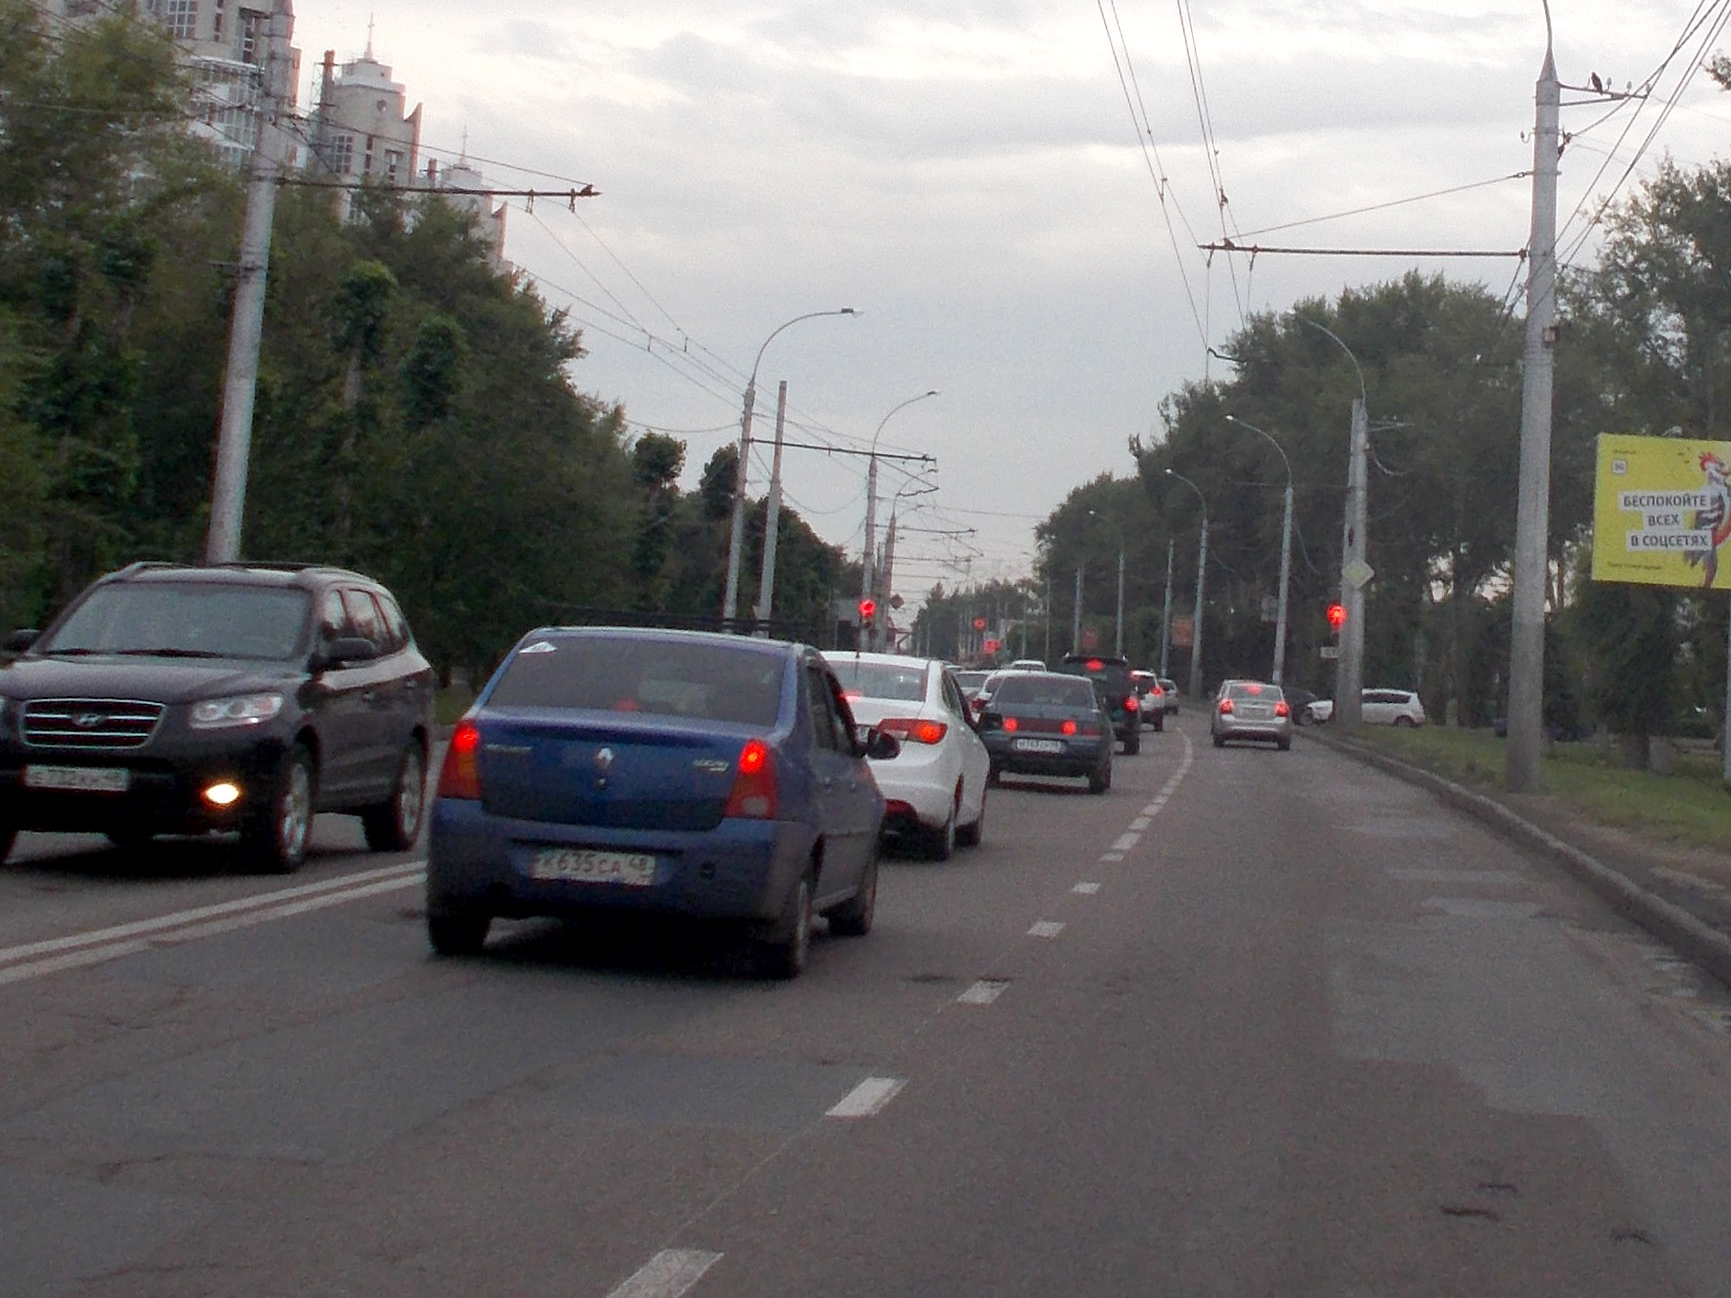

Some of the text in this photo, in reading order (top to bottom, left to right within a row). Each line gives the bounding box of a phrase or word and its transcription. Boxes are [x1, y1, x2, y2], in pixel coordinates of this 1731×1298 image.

[1623, 492, 1707, 508] БЕСПОКОЙТЕ
[1648, 514, 1680, 527] ВСЕХ
[1642, 535, 1709, 549] СОЦСЕТЯХ
